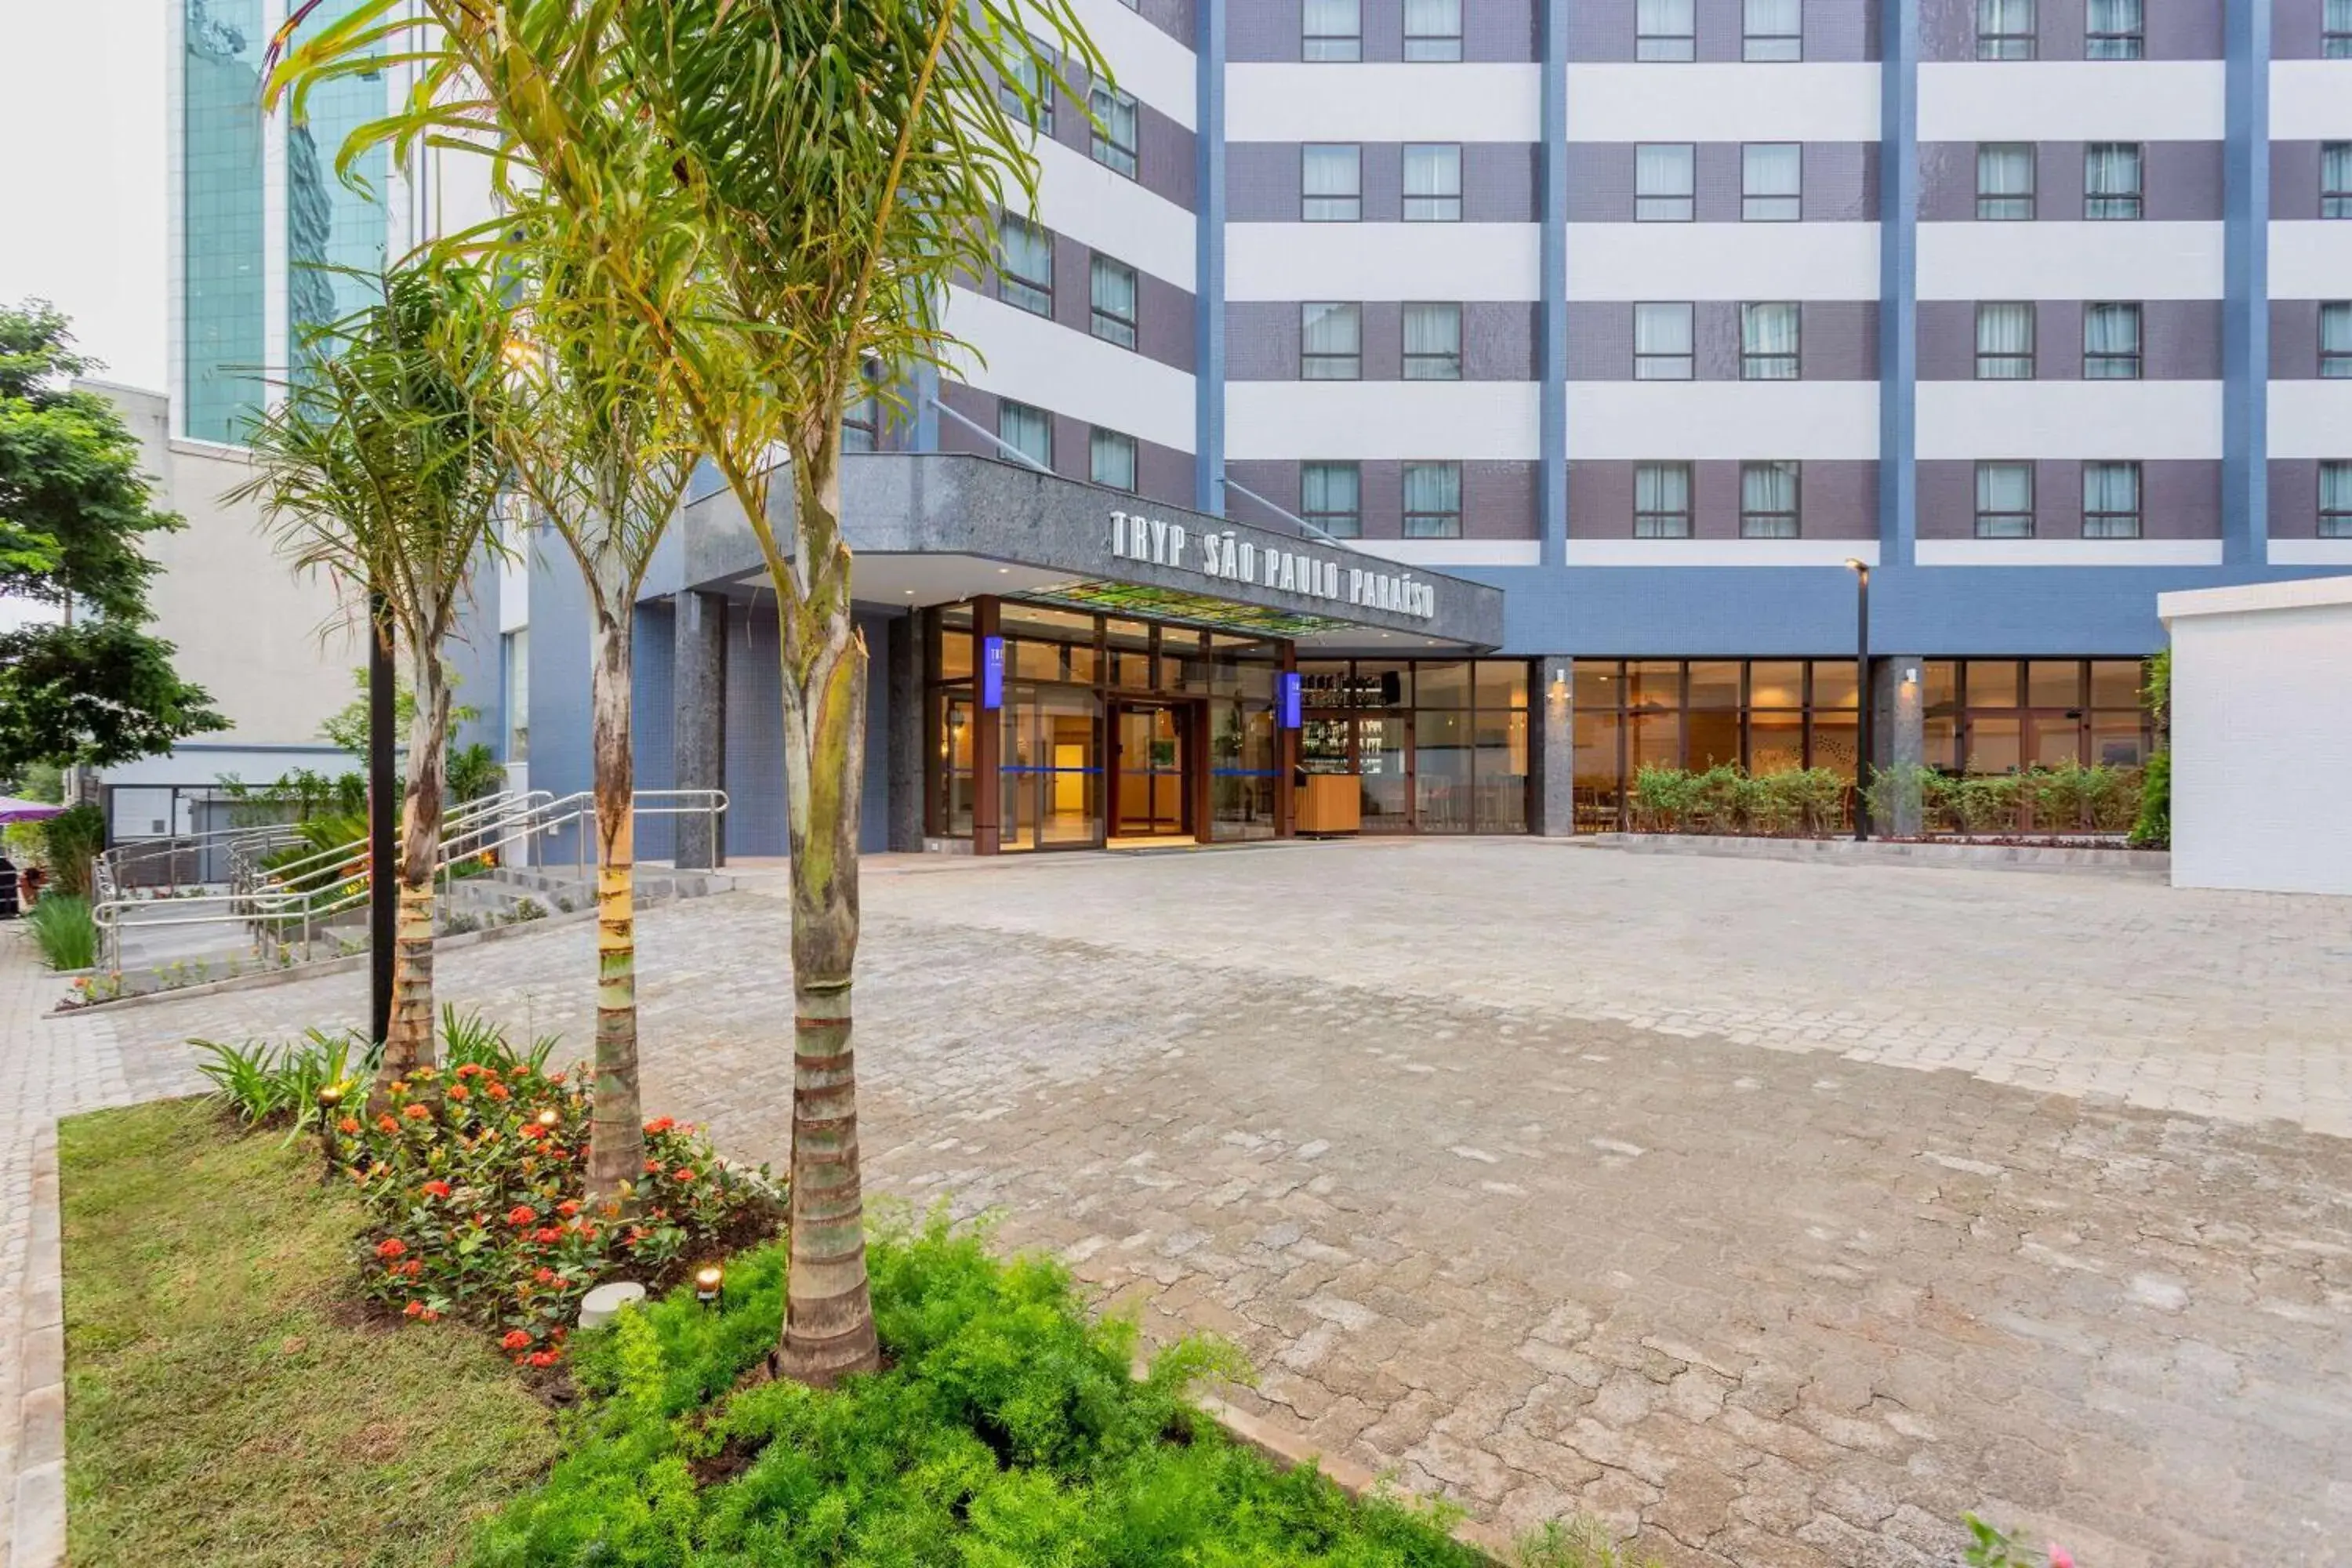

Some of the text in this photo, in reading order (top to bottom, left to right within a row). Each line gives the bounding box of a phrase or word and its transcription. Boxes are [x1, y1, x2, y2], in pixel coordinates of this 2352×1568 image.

[1110, 511, 1434, 618] TRYP SÃO PAULO PARAÍSO
